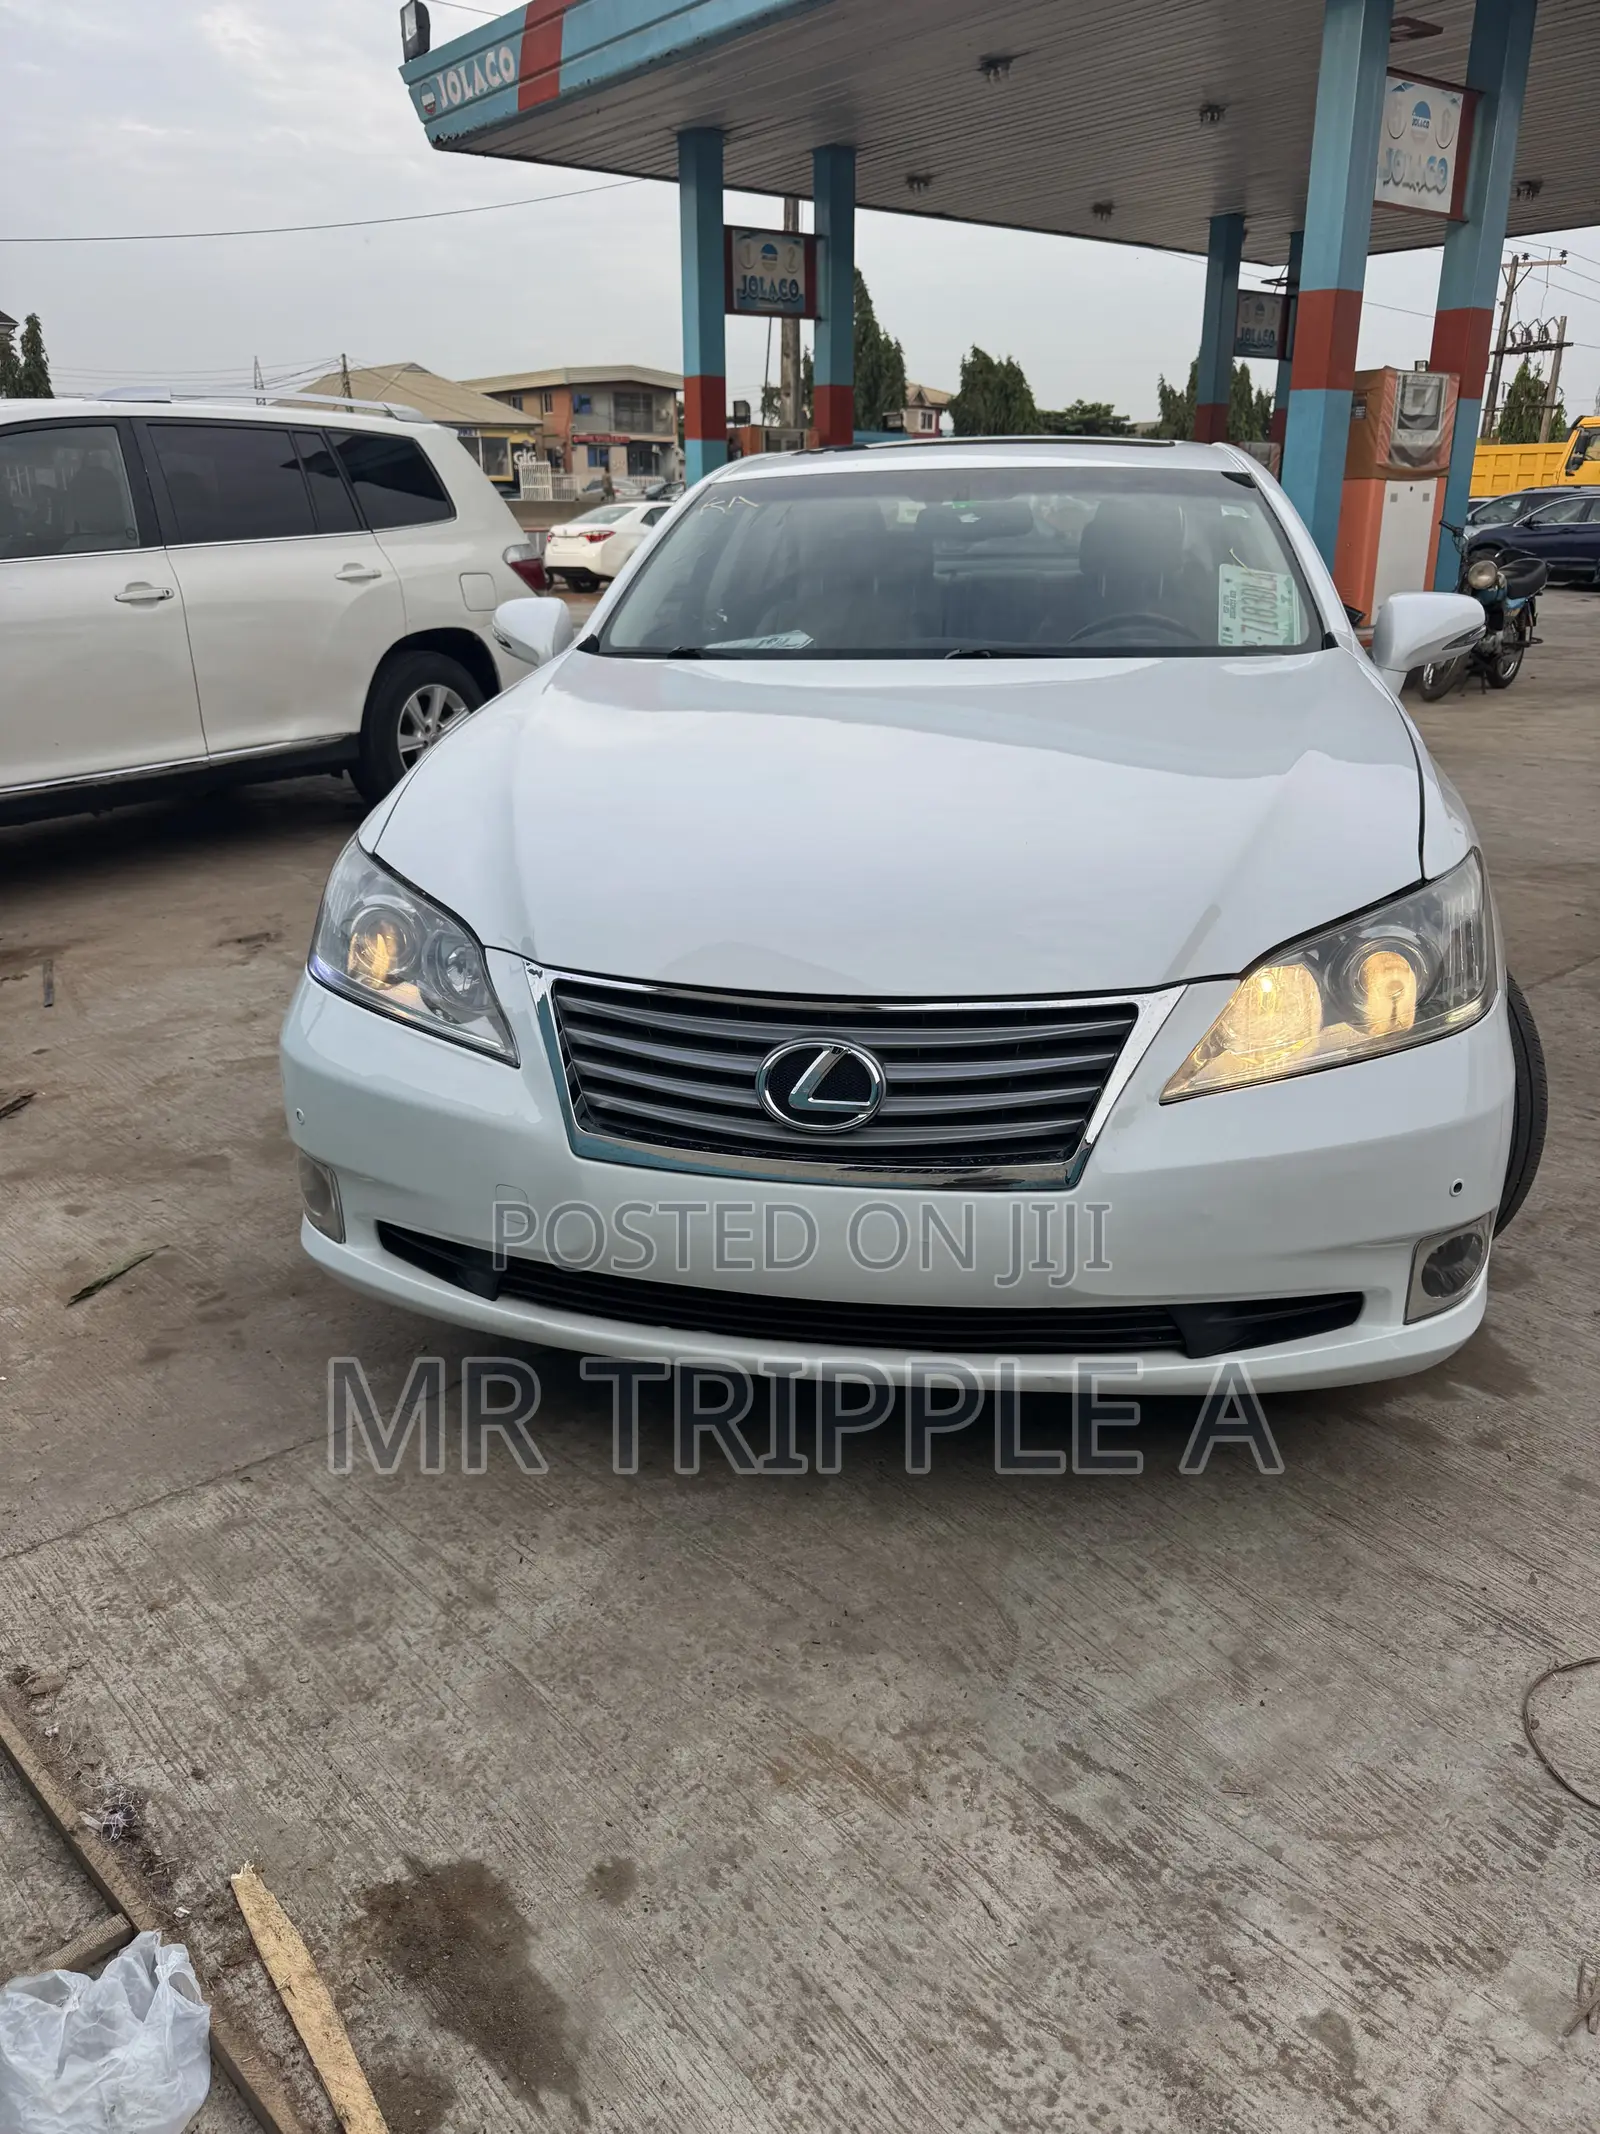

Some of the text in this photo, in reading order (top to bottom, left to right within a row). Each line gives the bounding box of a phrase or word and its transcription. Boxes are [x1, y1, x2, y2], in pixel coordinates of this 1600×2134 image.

[436, 46, 516, 109] JOLACO
[1383, 147, 1449, 192] JOCO
[740, 274, 800, 301] JOLACO
